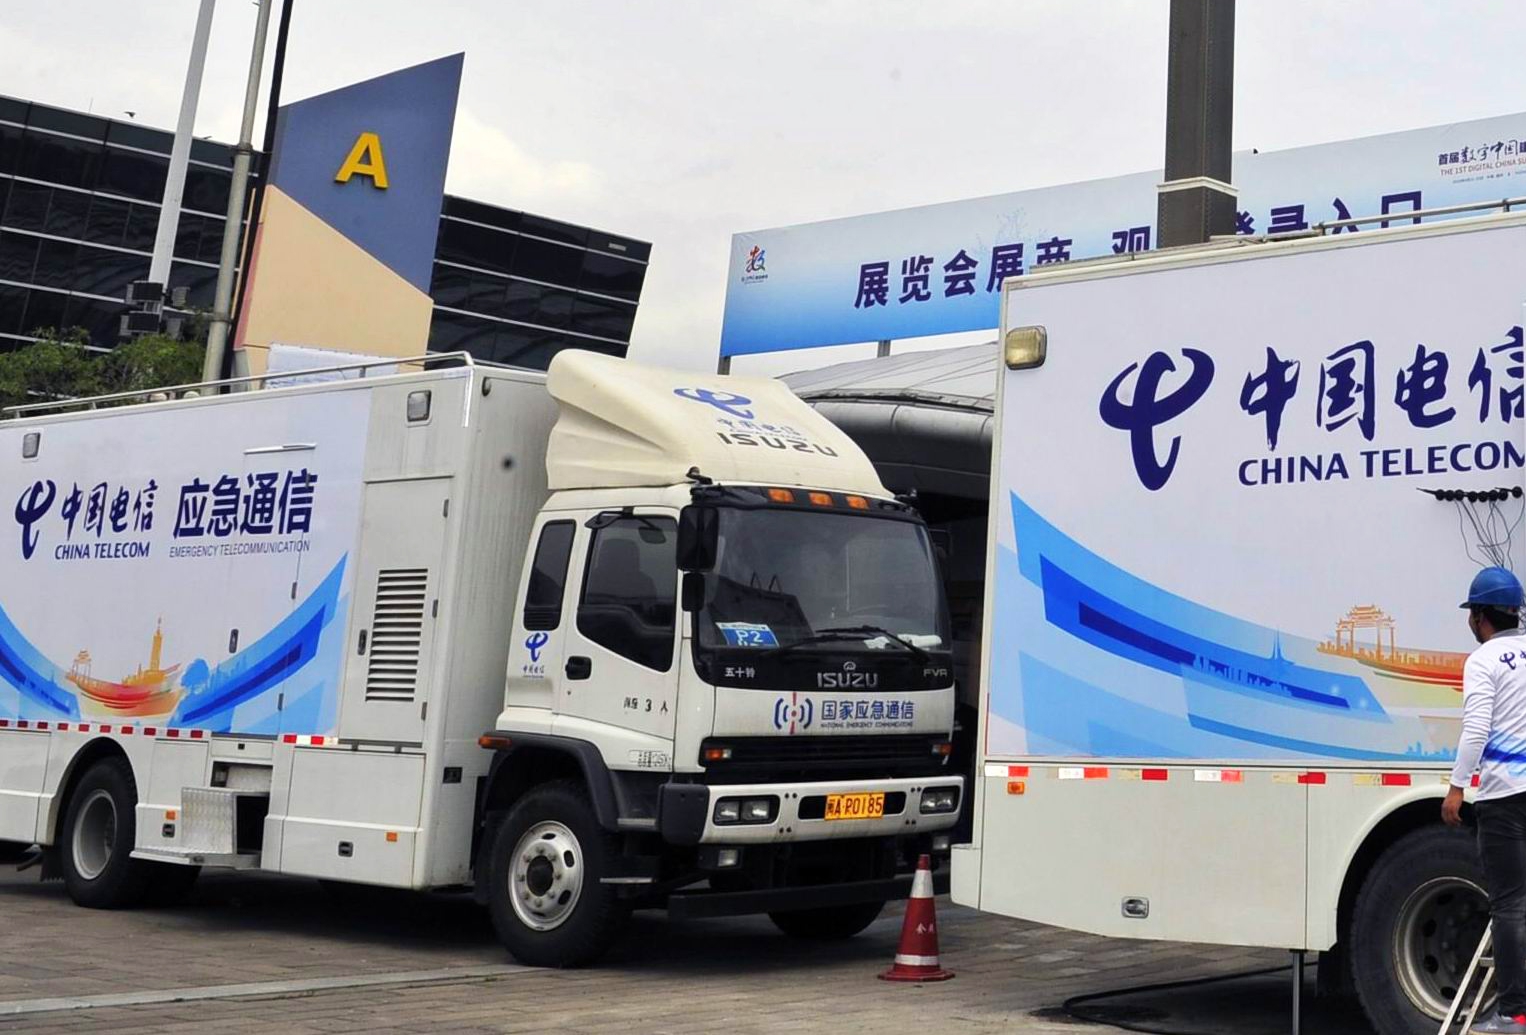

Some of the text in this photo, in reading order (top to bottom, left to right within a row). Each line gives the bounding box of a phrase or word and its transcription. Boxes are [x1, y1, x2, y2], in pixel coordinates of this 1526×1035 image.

[334, 132, 389, 190] A
[1441, 168, 1453, 176] THE
[1455, 166, 1467, 175] 1ST
[1467, 163, 1494, 172] DIGITAL
[1495, 158, 1516, 168] CHINA
[1240, 326, 1525, 451] 中国电信
[716, 431, 839, 458] ISUZU
[1238, 452, 1349, 486] CHINA
[60, 468, 318, 541] 中国电信 应急通信
[55, 541, 150, 560] CHINA TELECOM
[169, 540, 310, 558] EMERGENCY TELECOMMUNICATION
[725, 667, 755, 678] 五十铃
[817, 672, 878, 688] ISUZU
[923, 668, 948, 677] FVR
[821, 700, 915, 720] 国家应急通信
